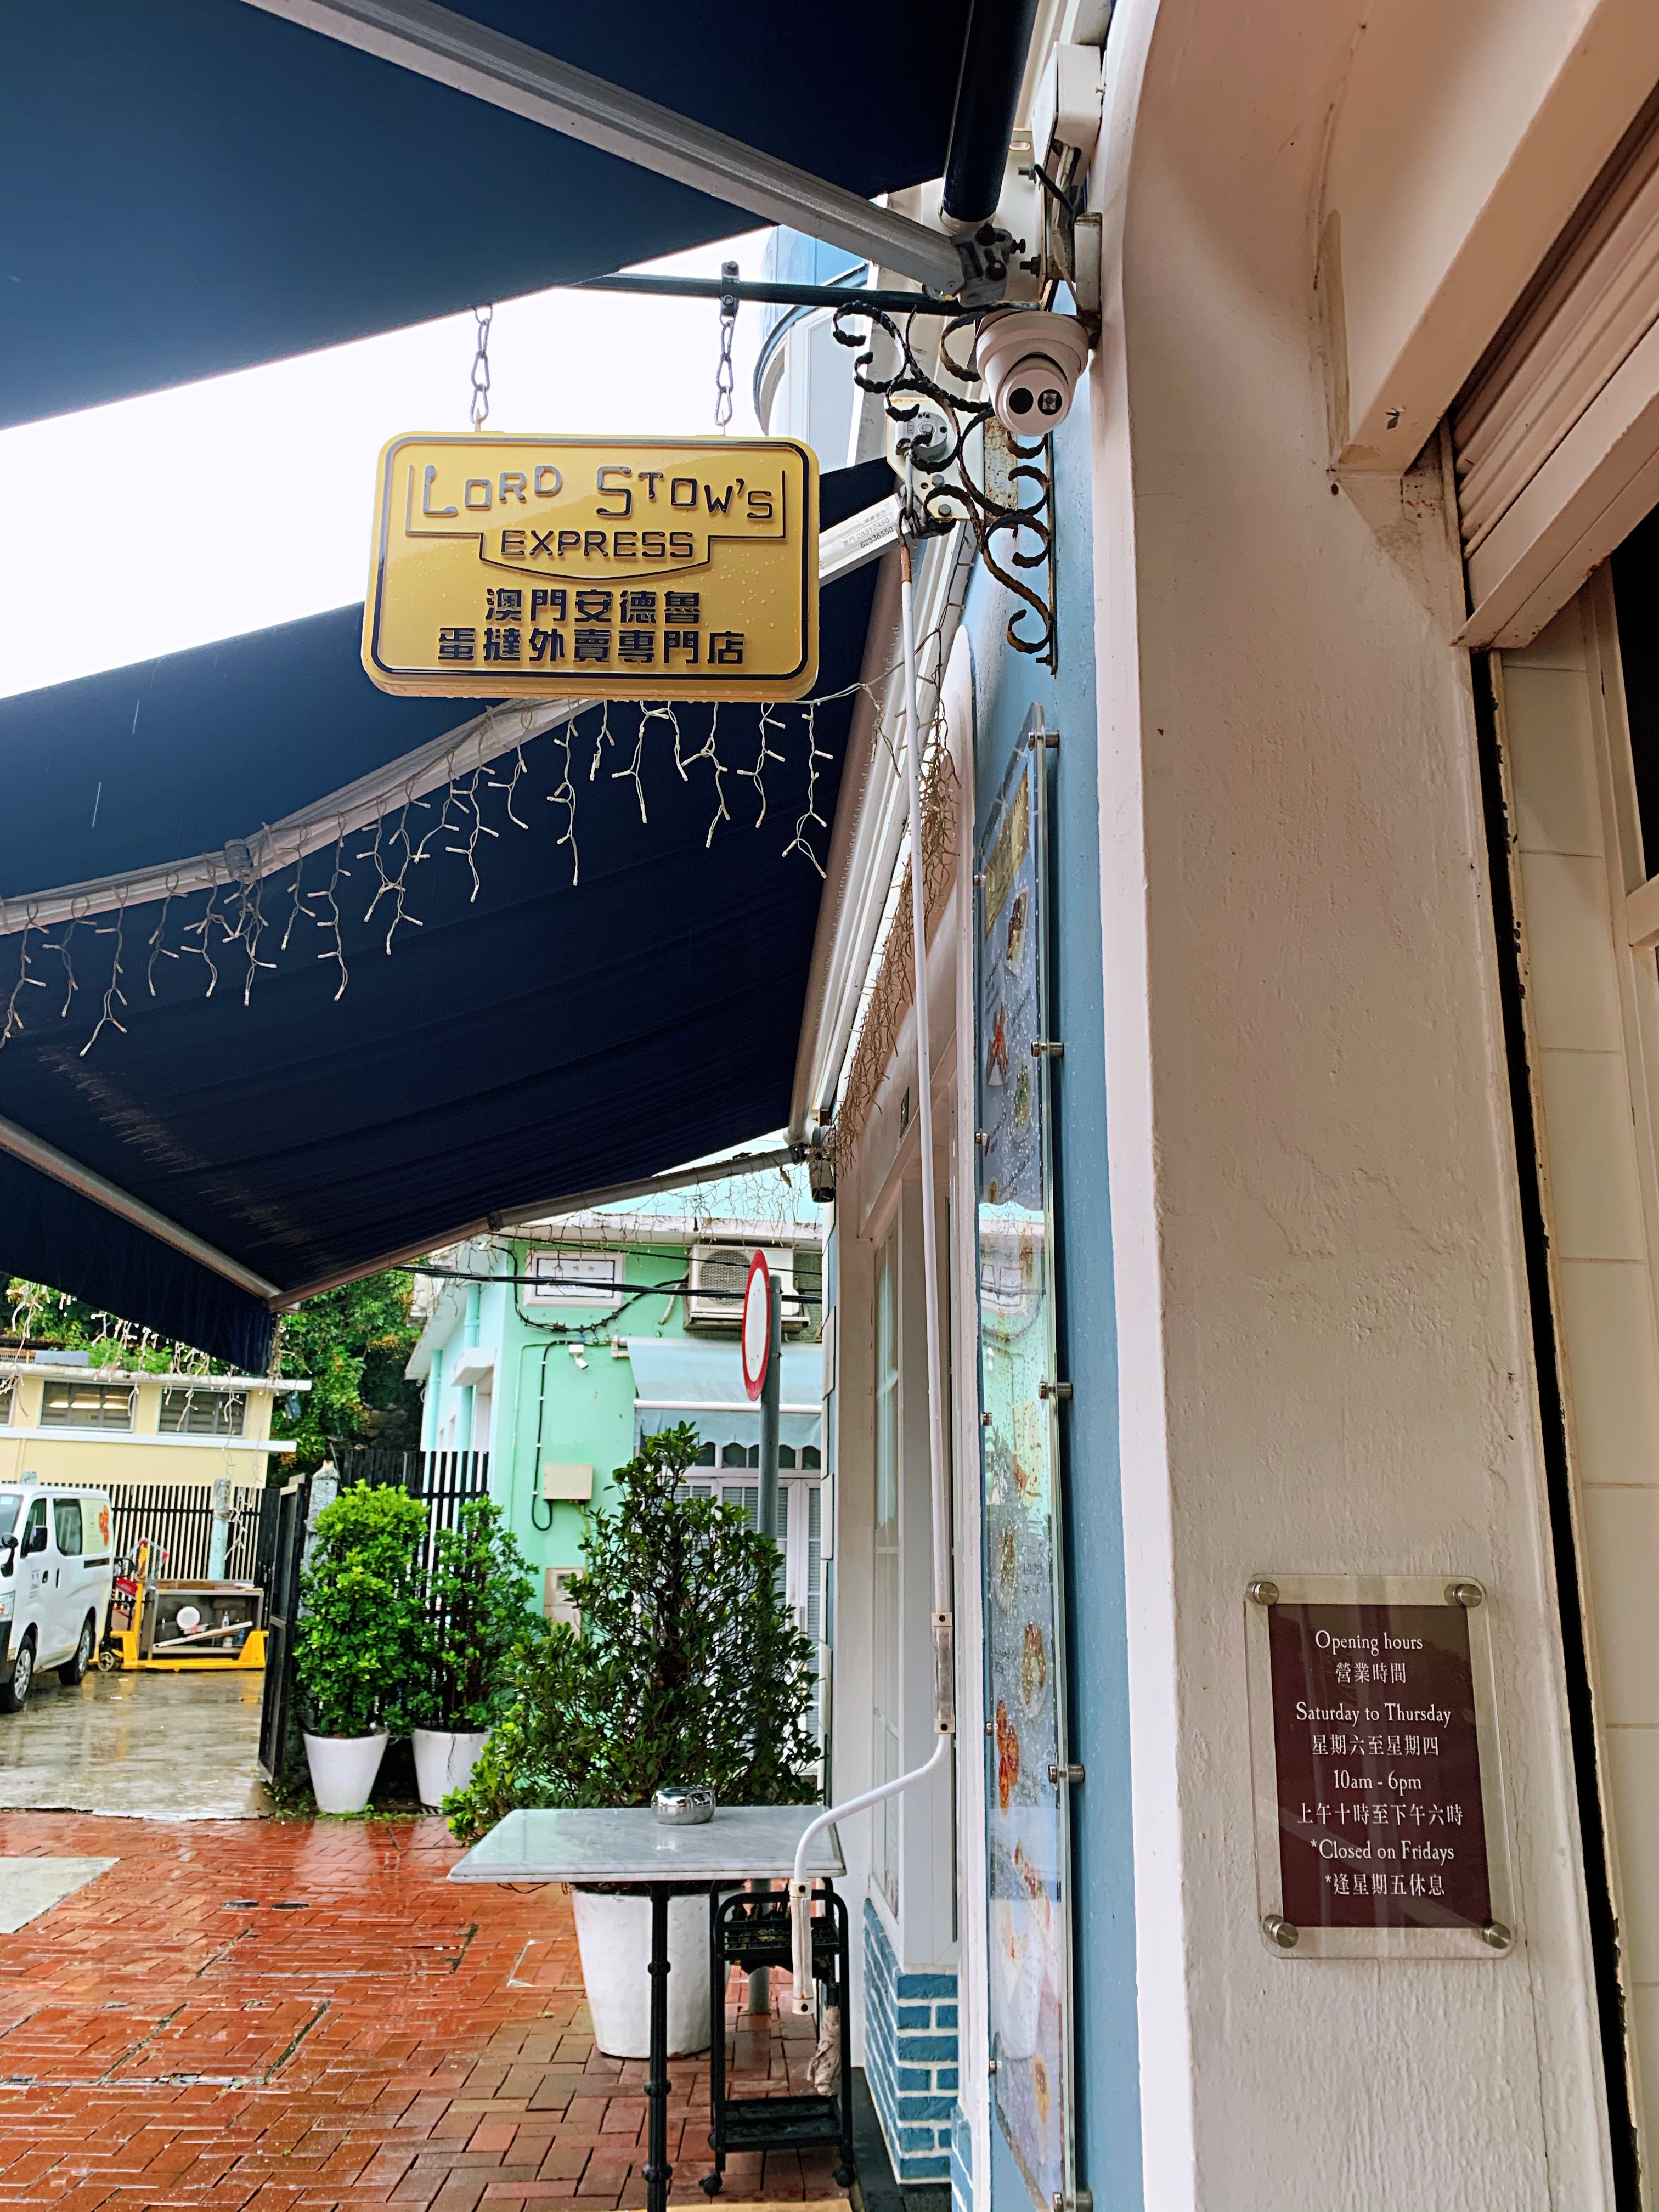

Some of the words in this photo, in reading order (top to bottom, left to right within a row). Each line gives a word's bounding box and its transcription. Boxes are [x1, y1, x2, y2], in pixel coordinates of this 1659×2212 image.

[422, 464, 563, 517] LORD
[595, 465, 773, 520] STOW'S
[857, 517, 890, 540] 28312450
[860, 526, 893, 548] 62338550
[500, 530, 695, 558] EXPRESS
[485, 587, 701, 624] 澳門安德魯
[438, 627, 744, 664] 蛋撻外賣專門店
[1315, 1629, 1379, 1656] Opening
[1384, 1632, 1424, 1650] hours
[1335, 1662, 1407, 1684] 營業時間
[1295, 1701, 1360, 1726] Saturday
[1365, 1707, 1380, 1722] to
[1384, 1702, 1452, 1727] Thursday
[1312, 1734, 1440, 1757] 星期六至星期四
[1334, 1770, 1373, 1789] 10am
[1387, 1770, 1422, 1796] 6pm
[1297, 1803, 1463, 1826] 上午十時至下午六時
[1377, 1847, 1396, 1859] on
[1401, 1840, 1454, 1866] Fridays
